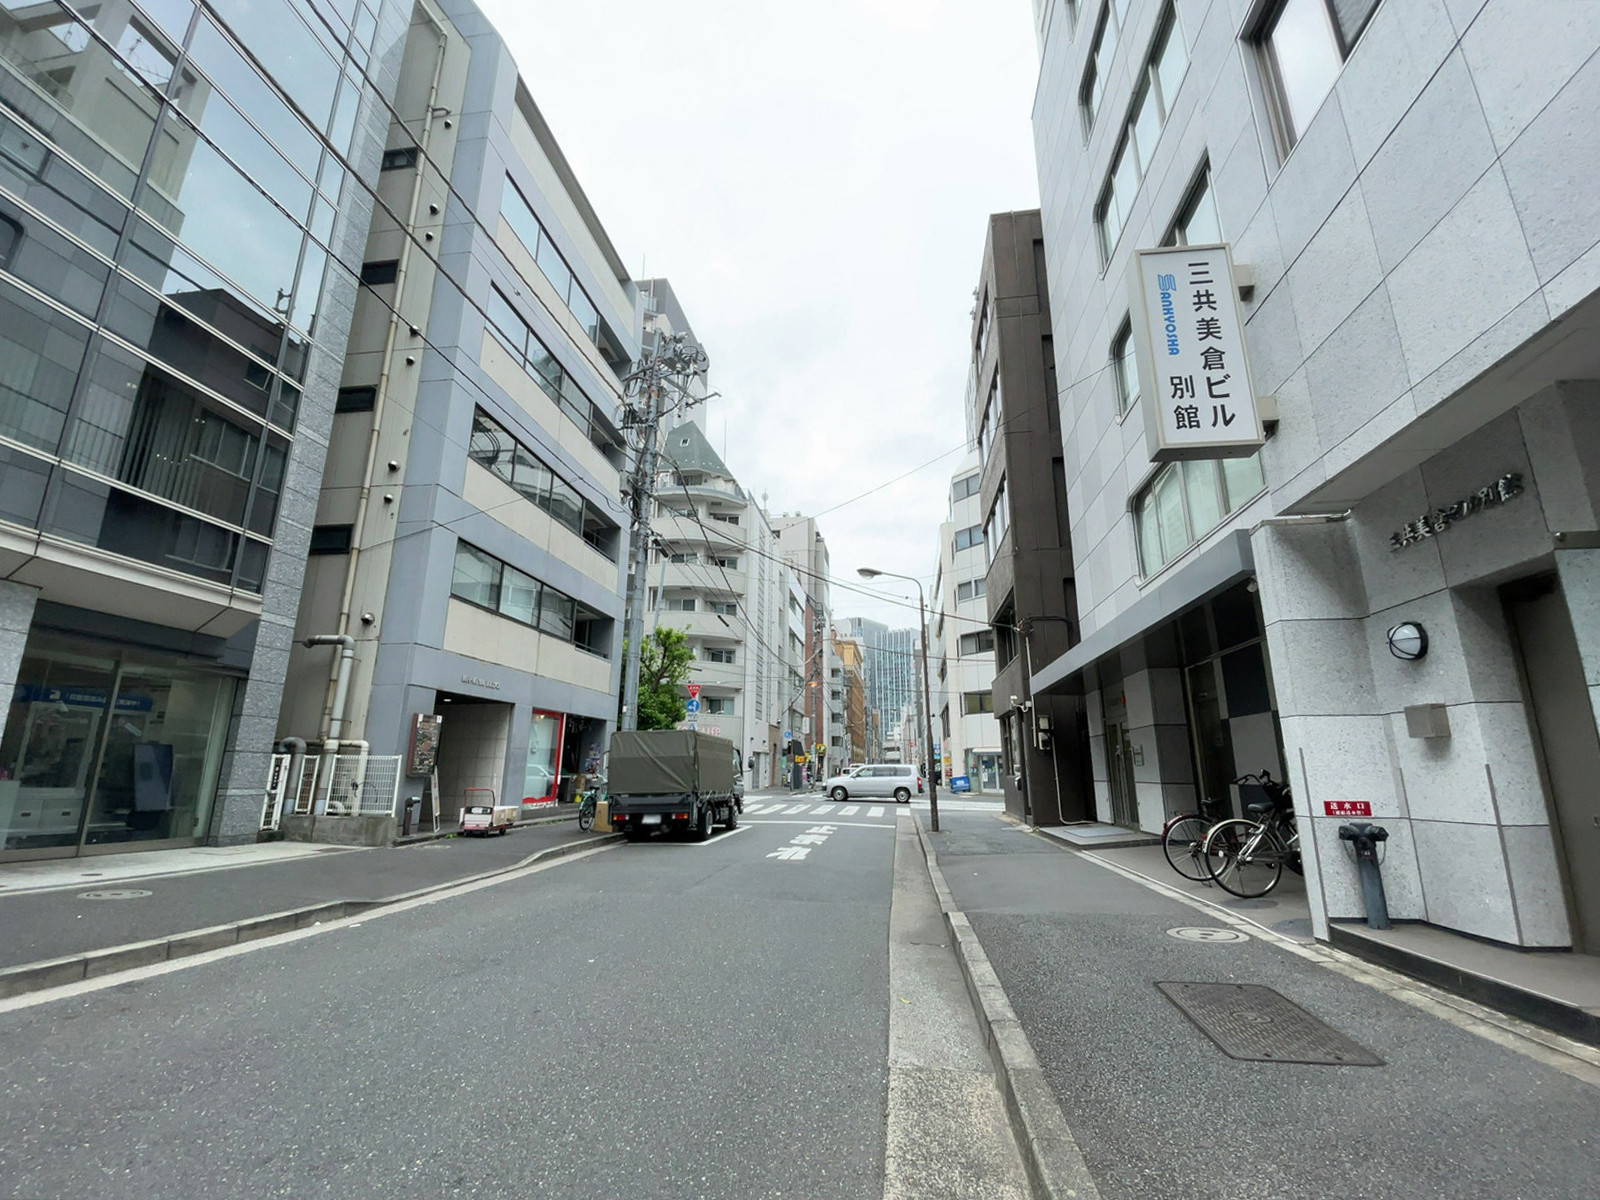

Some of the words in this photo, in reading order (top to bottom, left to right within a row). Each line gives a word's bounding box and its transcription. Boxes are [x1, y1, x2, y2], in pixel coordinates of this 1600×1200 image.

[1188, 262, 1236, 428] 三共美倉ビル
[1170, 374, 1201, 430] 別館
